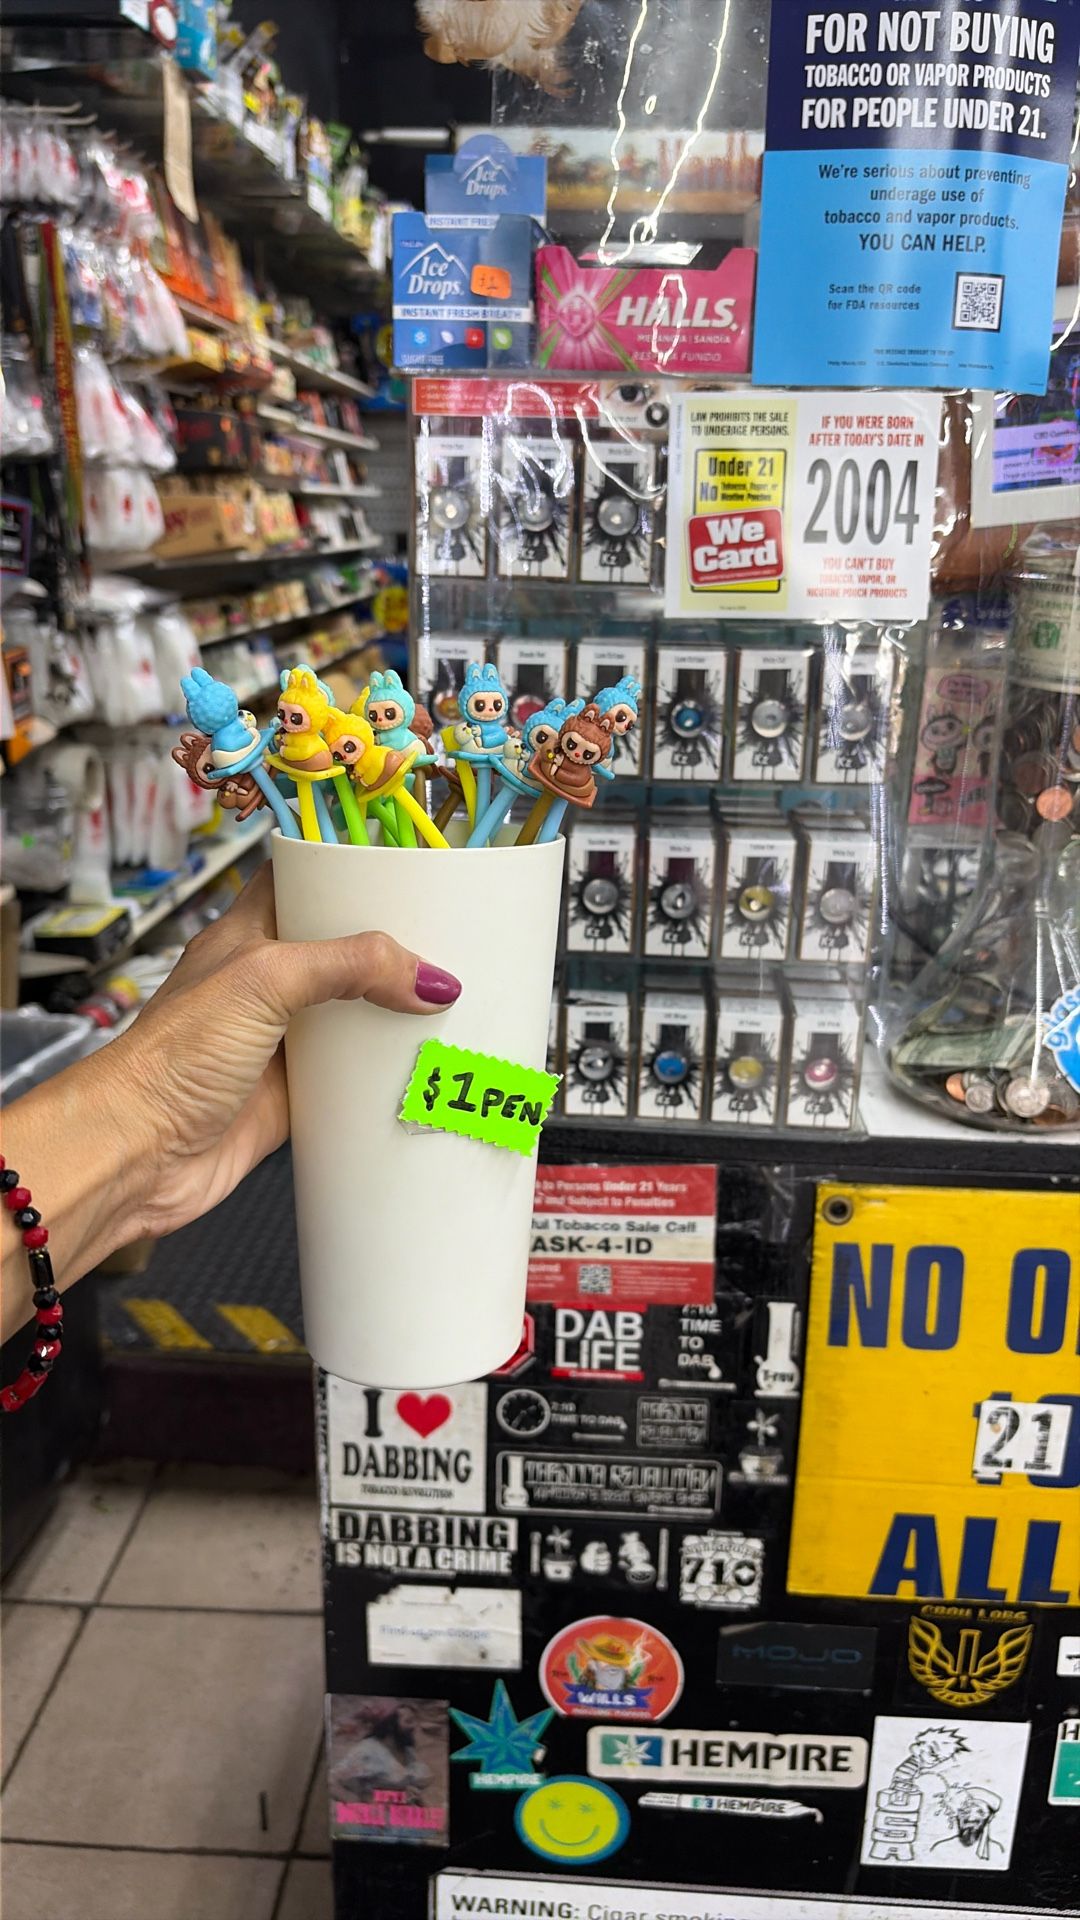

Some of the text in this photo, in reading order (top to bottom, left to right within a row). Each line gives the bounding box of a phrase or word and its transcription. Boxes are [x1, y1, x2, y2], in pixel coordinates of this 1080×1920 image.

[806, 11, 1055, 64] FOR NOT BUYING
[805, 63, 1051, 98] TOBACCO OR VAPOR PRODUCTS
[801, 97, 1047, 140] FOR PEOPLE UNDER 21.
[474, 166, 499, 182] Ice
[819, 164, 1032, 189] We're serious about preventing
[870, 187, 985, 204] underage use of
[825, 210, 1019, 230] tobacco and vapor products.
[859, 233, 987, 253] YOU CAN HELP.
[420, 256, 449, 277] Ice
[828, 284, 922, 295] Scan the QR code
[400, 308, 445, 317] INSTANT
[447, 308, 479, 318] FRESH
[827, 300, 920, 311] for FDA resources
[709, 412, 751, 423] PROHIBITS
[753, 412, 767, 423] THE
[769, 412, 789, 423] SALE
[821, 415, 914, 429] IF YOU WERE BORN
[691, 425, 702, 436] TO
[704, 425, 748, 436] UNDERAGE
[809, 432, 925, 447] AFTER TODAY'S DATE IN
[708, 456, 774, 477] Under 21
[700, 482, 718, 501] No
[803, 457, 921, 546] 2004
[705, 516, 765, 546] We
[693, 538, 778, 573] Card
[822, 556, 895, 571] YOU CAN'T BUY
[869, 587, 908, 598] PRODUCTS
[480, 1087, 544, 1126] PEN
[557, 1181, 600, 1192] Persons
[603, 1181, 635, 1192] Under
[639, 1182, 653, 1192] 21
[656, 1182, 688, 1193] Years
[568, 1196, 609, 1208] Subject
[611, 1197, 622, 1206] to
[624, 1198, 676, 1208] Penalties
[554, 1219, 621, 1231] Tobacco
[626, 1221, 661, 1233] Sale
[665, 1221, 697, 1233] Call
[826, 1242, 966, 1351] NO
[555, 1308, 644, 1341] DAB
[679, 1318, 723, 1334] TIME
[678, 1336, 705, 1350] TO
[555, 1337, 642, 1372] LIFE
[677, 1353, 715, 1368] DAB
[363, 1388, 383, 1438] I
[980, 1405, 1055, 1472] 21
[342, 1441, 473, 1484] DABBING
[338, 1512, 511, 1550] DABBING
[335, 1543, 512, 1574] IS NOT A CRIME
[868, 1512, 1080, 1606] ALL
[685, 1557, 757, 1587] 710
[732, 1644, 864, 1664] MOJO
[577, 1691, 637, 1706] WILLS
[671, 1738, 853, 1774] HEMPIRE
[472, 1772, 543, 1786] HEMPIRE
[716, 1798, 788, 1814] HEMPIRE
[452, 1893, 580, 1920] WARNING:
